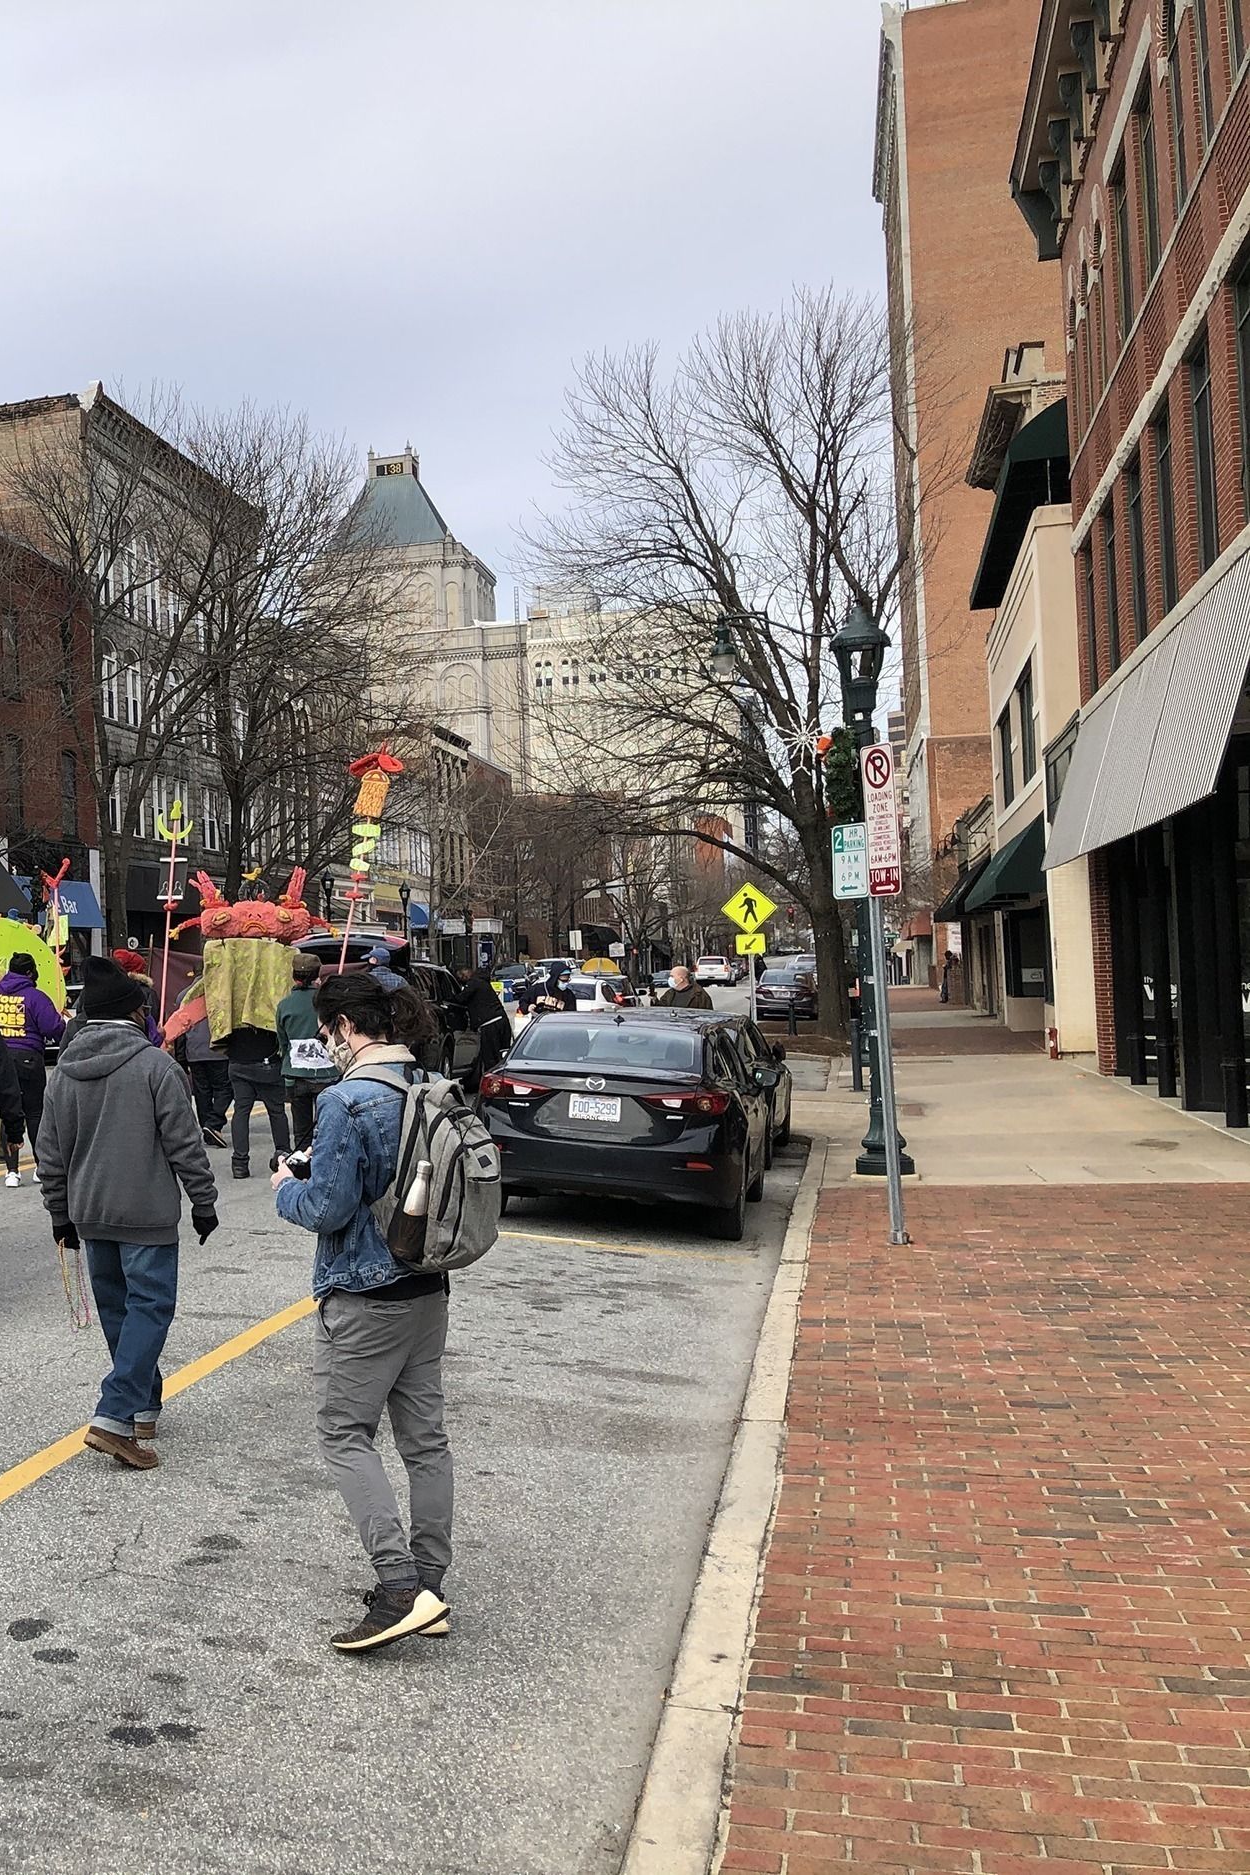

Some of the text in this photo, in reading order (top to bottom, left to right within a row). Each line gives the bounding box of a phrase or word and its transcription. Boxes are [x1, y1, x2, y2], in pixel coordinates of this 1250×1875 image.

[867, 790, 892, 803] LOADING
[873, 803, 889, 813] ZONE
[834, 831, 843, 849] 2
[844, 838, 865, 848] PARKING
[60, 895, 79, 914] Bar
